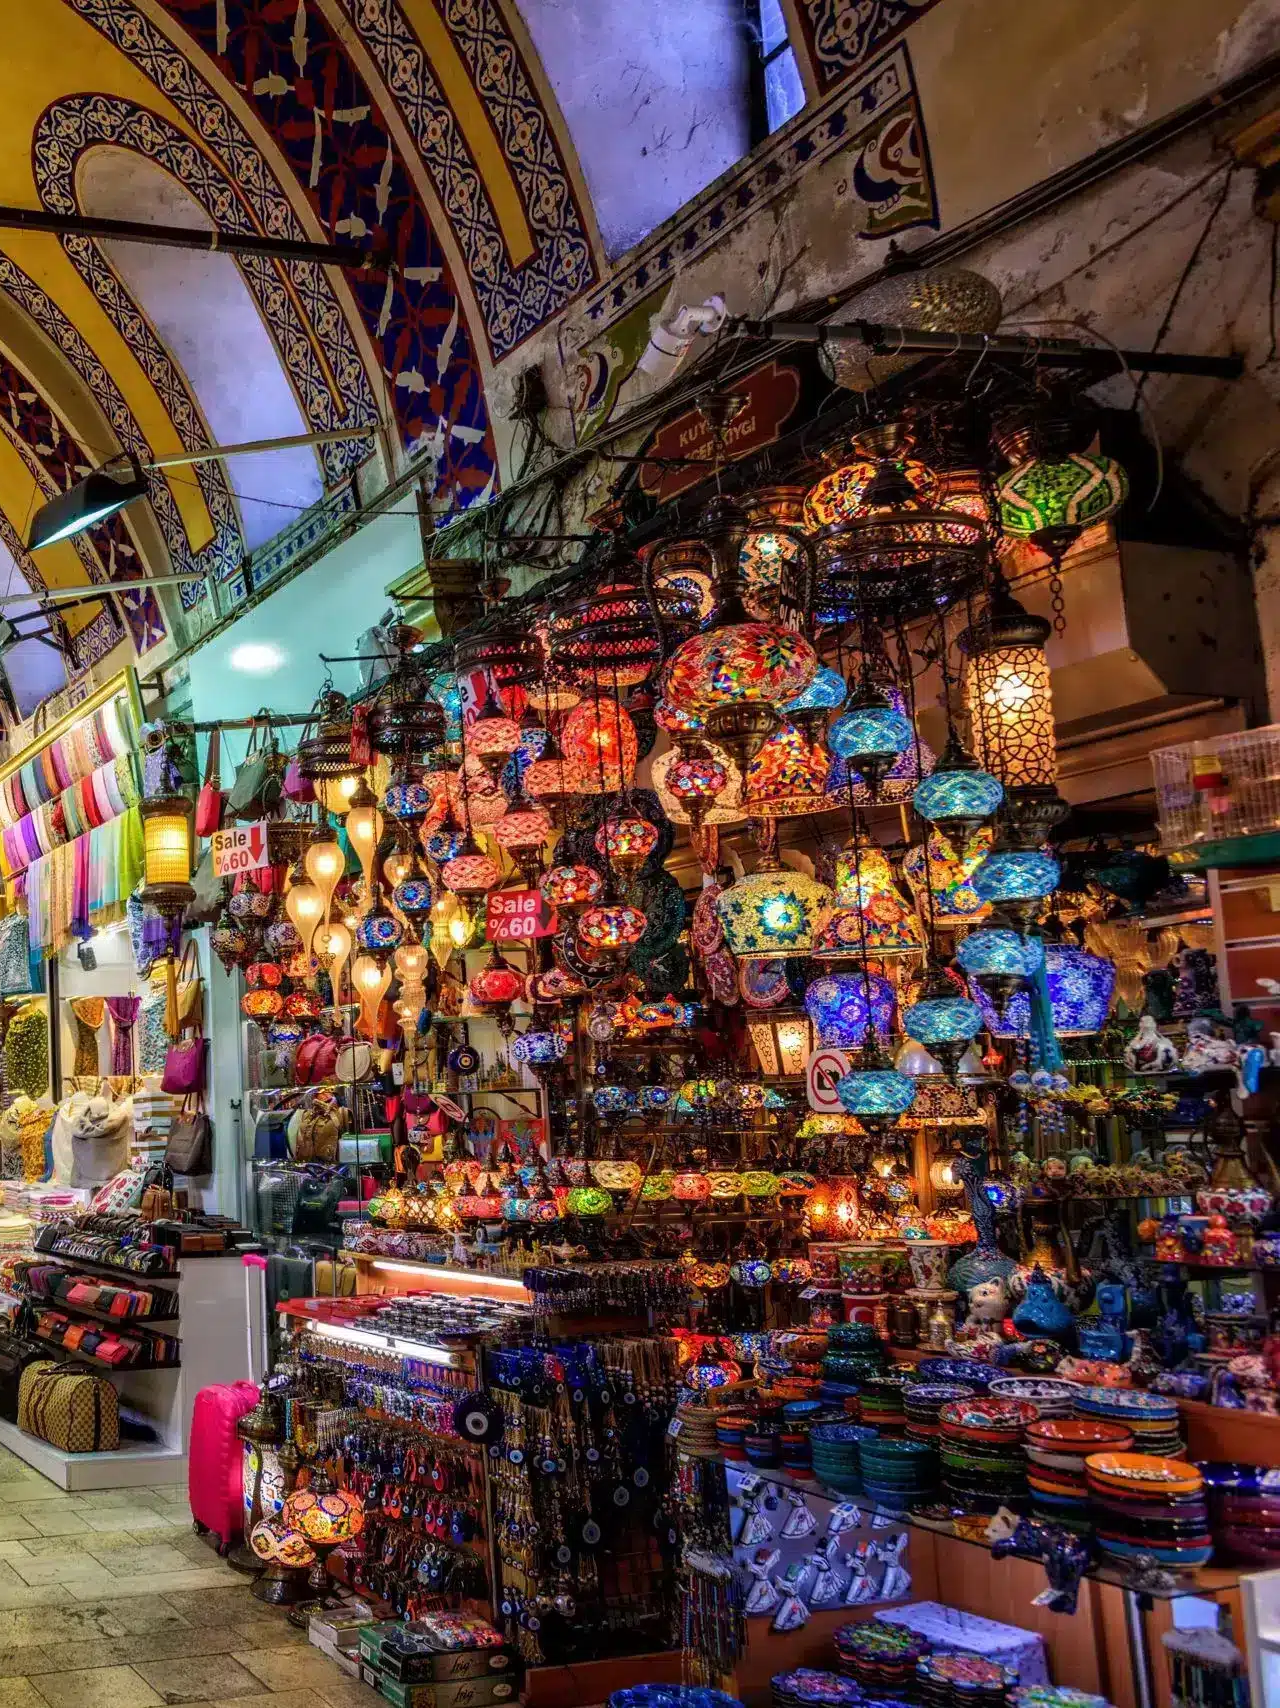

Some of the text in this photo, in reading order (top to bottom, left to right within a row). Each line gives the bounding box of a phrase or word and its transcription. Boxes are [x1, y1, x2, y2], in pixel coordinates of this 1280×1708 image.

[215, 831, 246, 851] Sale
[216, 850, 249, 874] %60
[490, 894, 536, 914] Sale
[489, 917, 536, 938] %60
